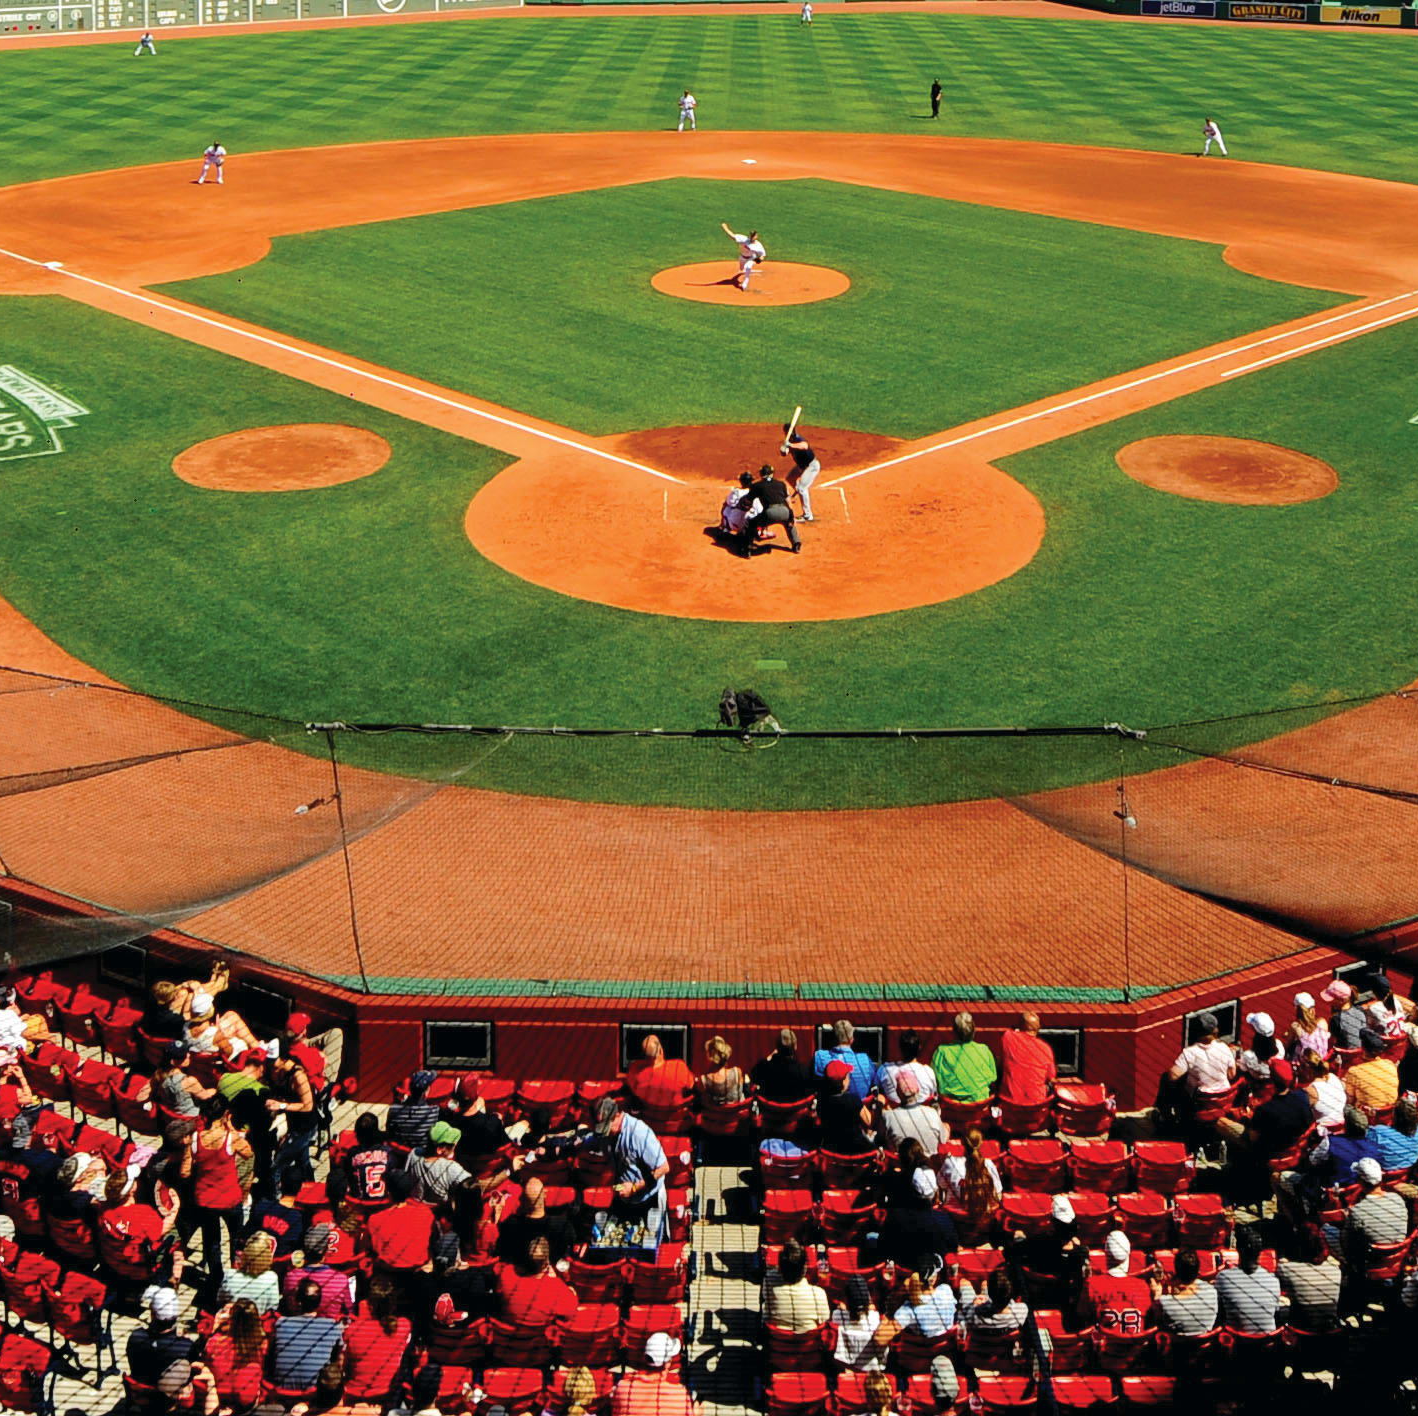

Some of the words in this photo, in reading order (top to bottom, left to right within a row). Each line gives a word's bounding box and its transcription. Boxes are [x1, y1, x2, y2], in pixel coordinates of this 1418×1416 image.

[1160, 2, 1196, 14] jetBlue
[1232, 4, 1277, 17] GRANITE
[1280, 6, 1304, 19] CITY
[26, 13, 42, 21] OUT
[1341, 10, 1380, 22] Nikon
